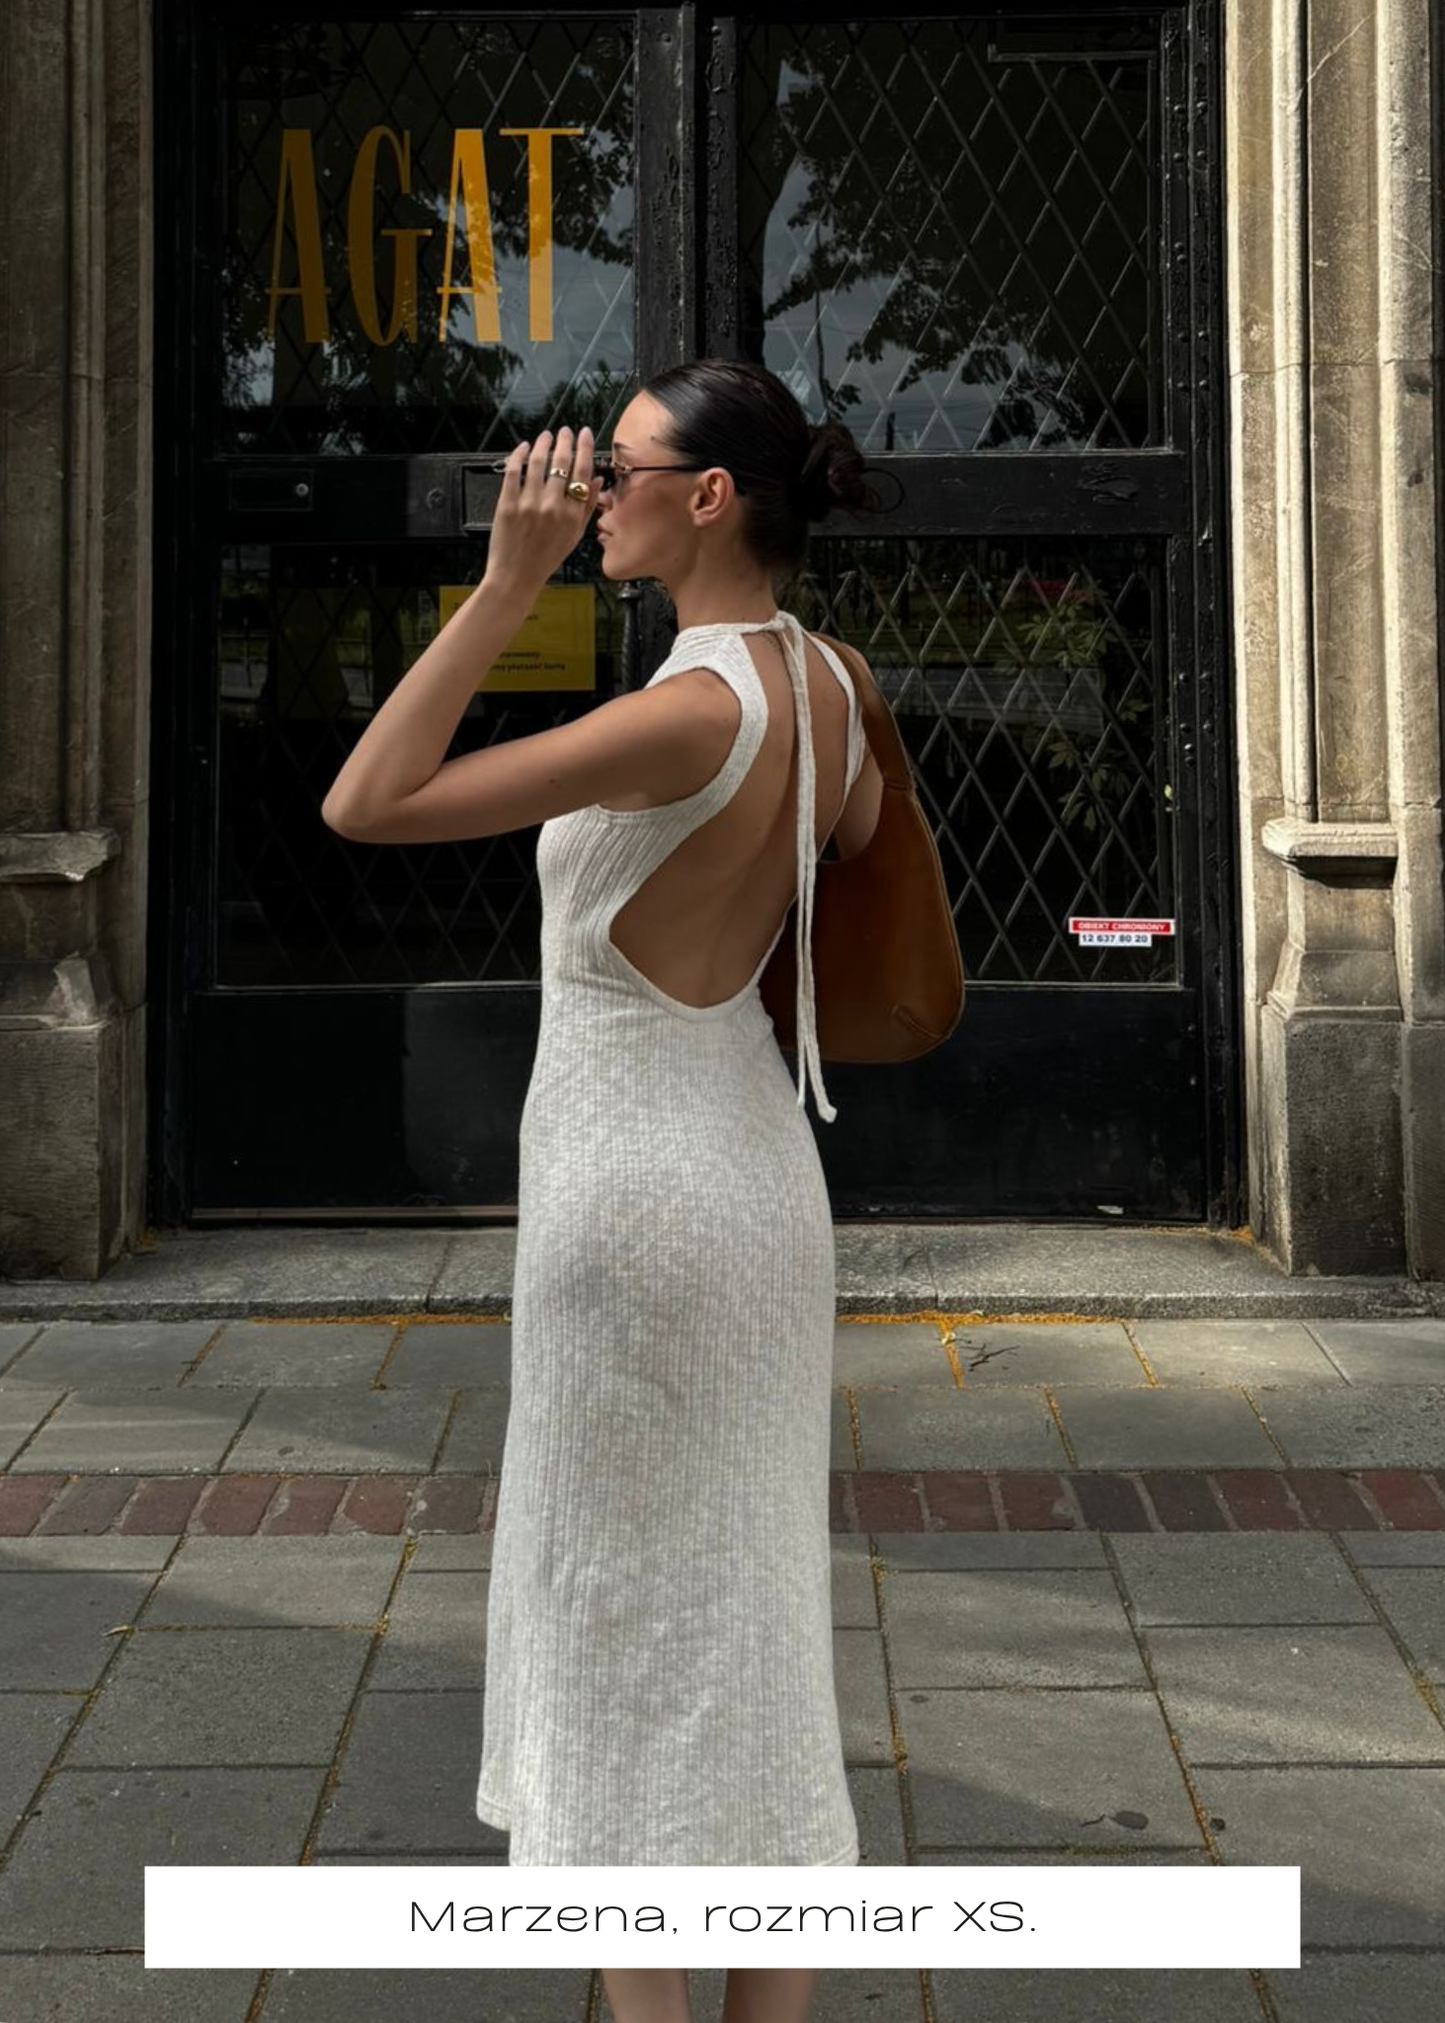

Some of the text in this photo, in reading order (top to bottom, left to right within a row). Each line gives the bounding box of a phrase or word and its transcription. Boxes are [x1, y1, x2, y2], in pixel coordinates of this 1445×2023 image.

[265, 125, 584, 347] AGAT
[1082, 933, 1094, 943] 12
[1097, 934, 1115, 943] 637
[1135, 934, 1148, 943] 20
